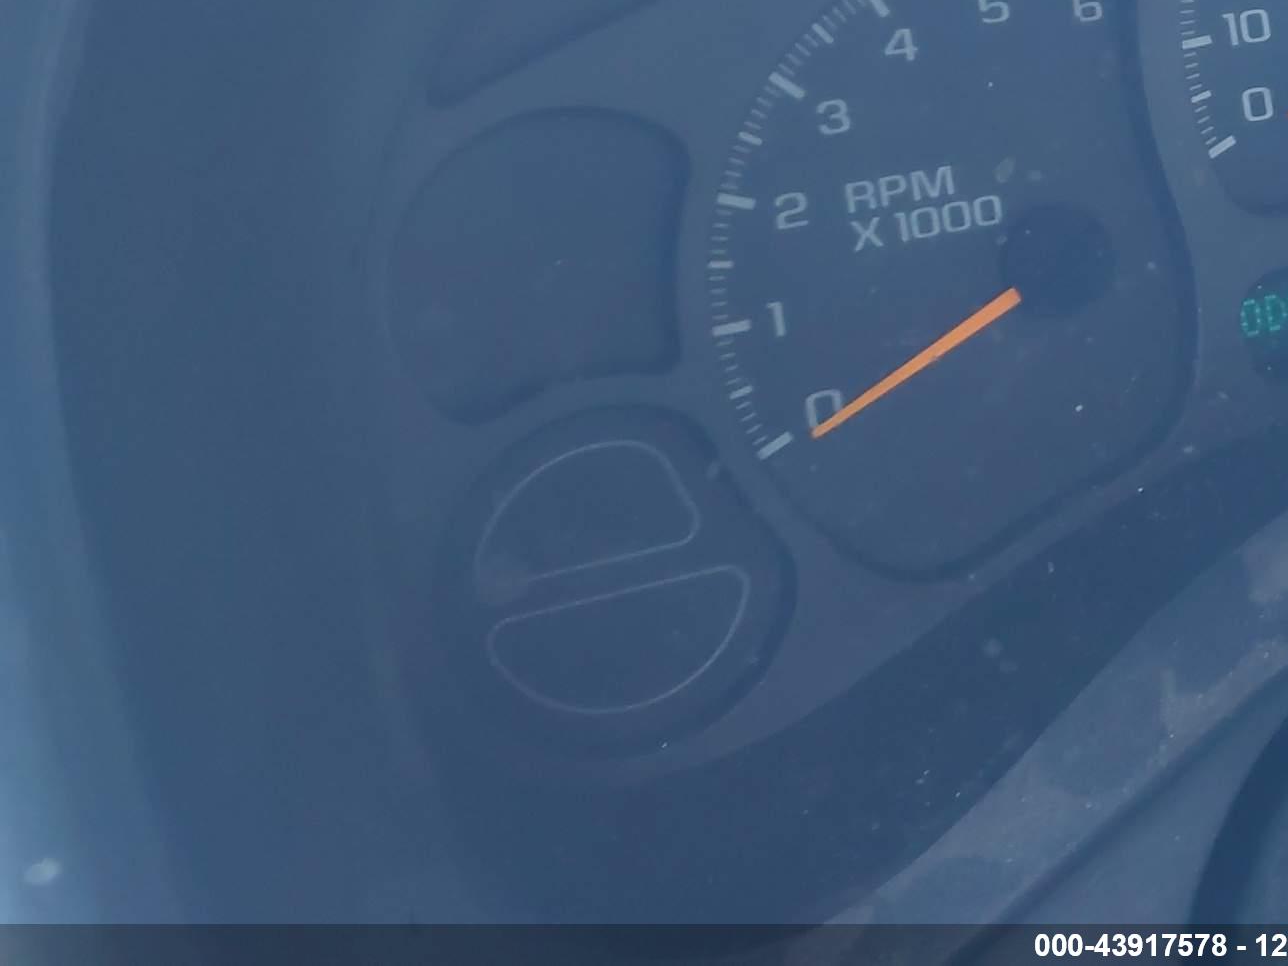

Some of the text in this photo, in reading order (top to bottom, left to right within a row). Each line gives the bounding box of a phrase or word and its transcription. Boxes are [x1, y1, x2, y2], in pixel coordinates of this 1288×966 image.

[884, 27, 919, 62] 4
[1221, 8, 1272, 46] 10
[814, 98, 852, 136] 3
[1241, 86, 1274, 122] 0
[844, 165, 956, 215] RPM
[774, 191, 809, 230] 2
[765, 301, 785, 337] 1
[804, 388, 844, 430] 0
